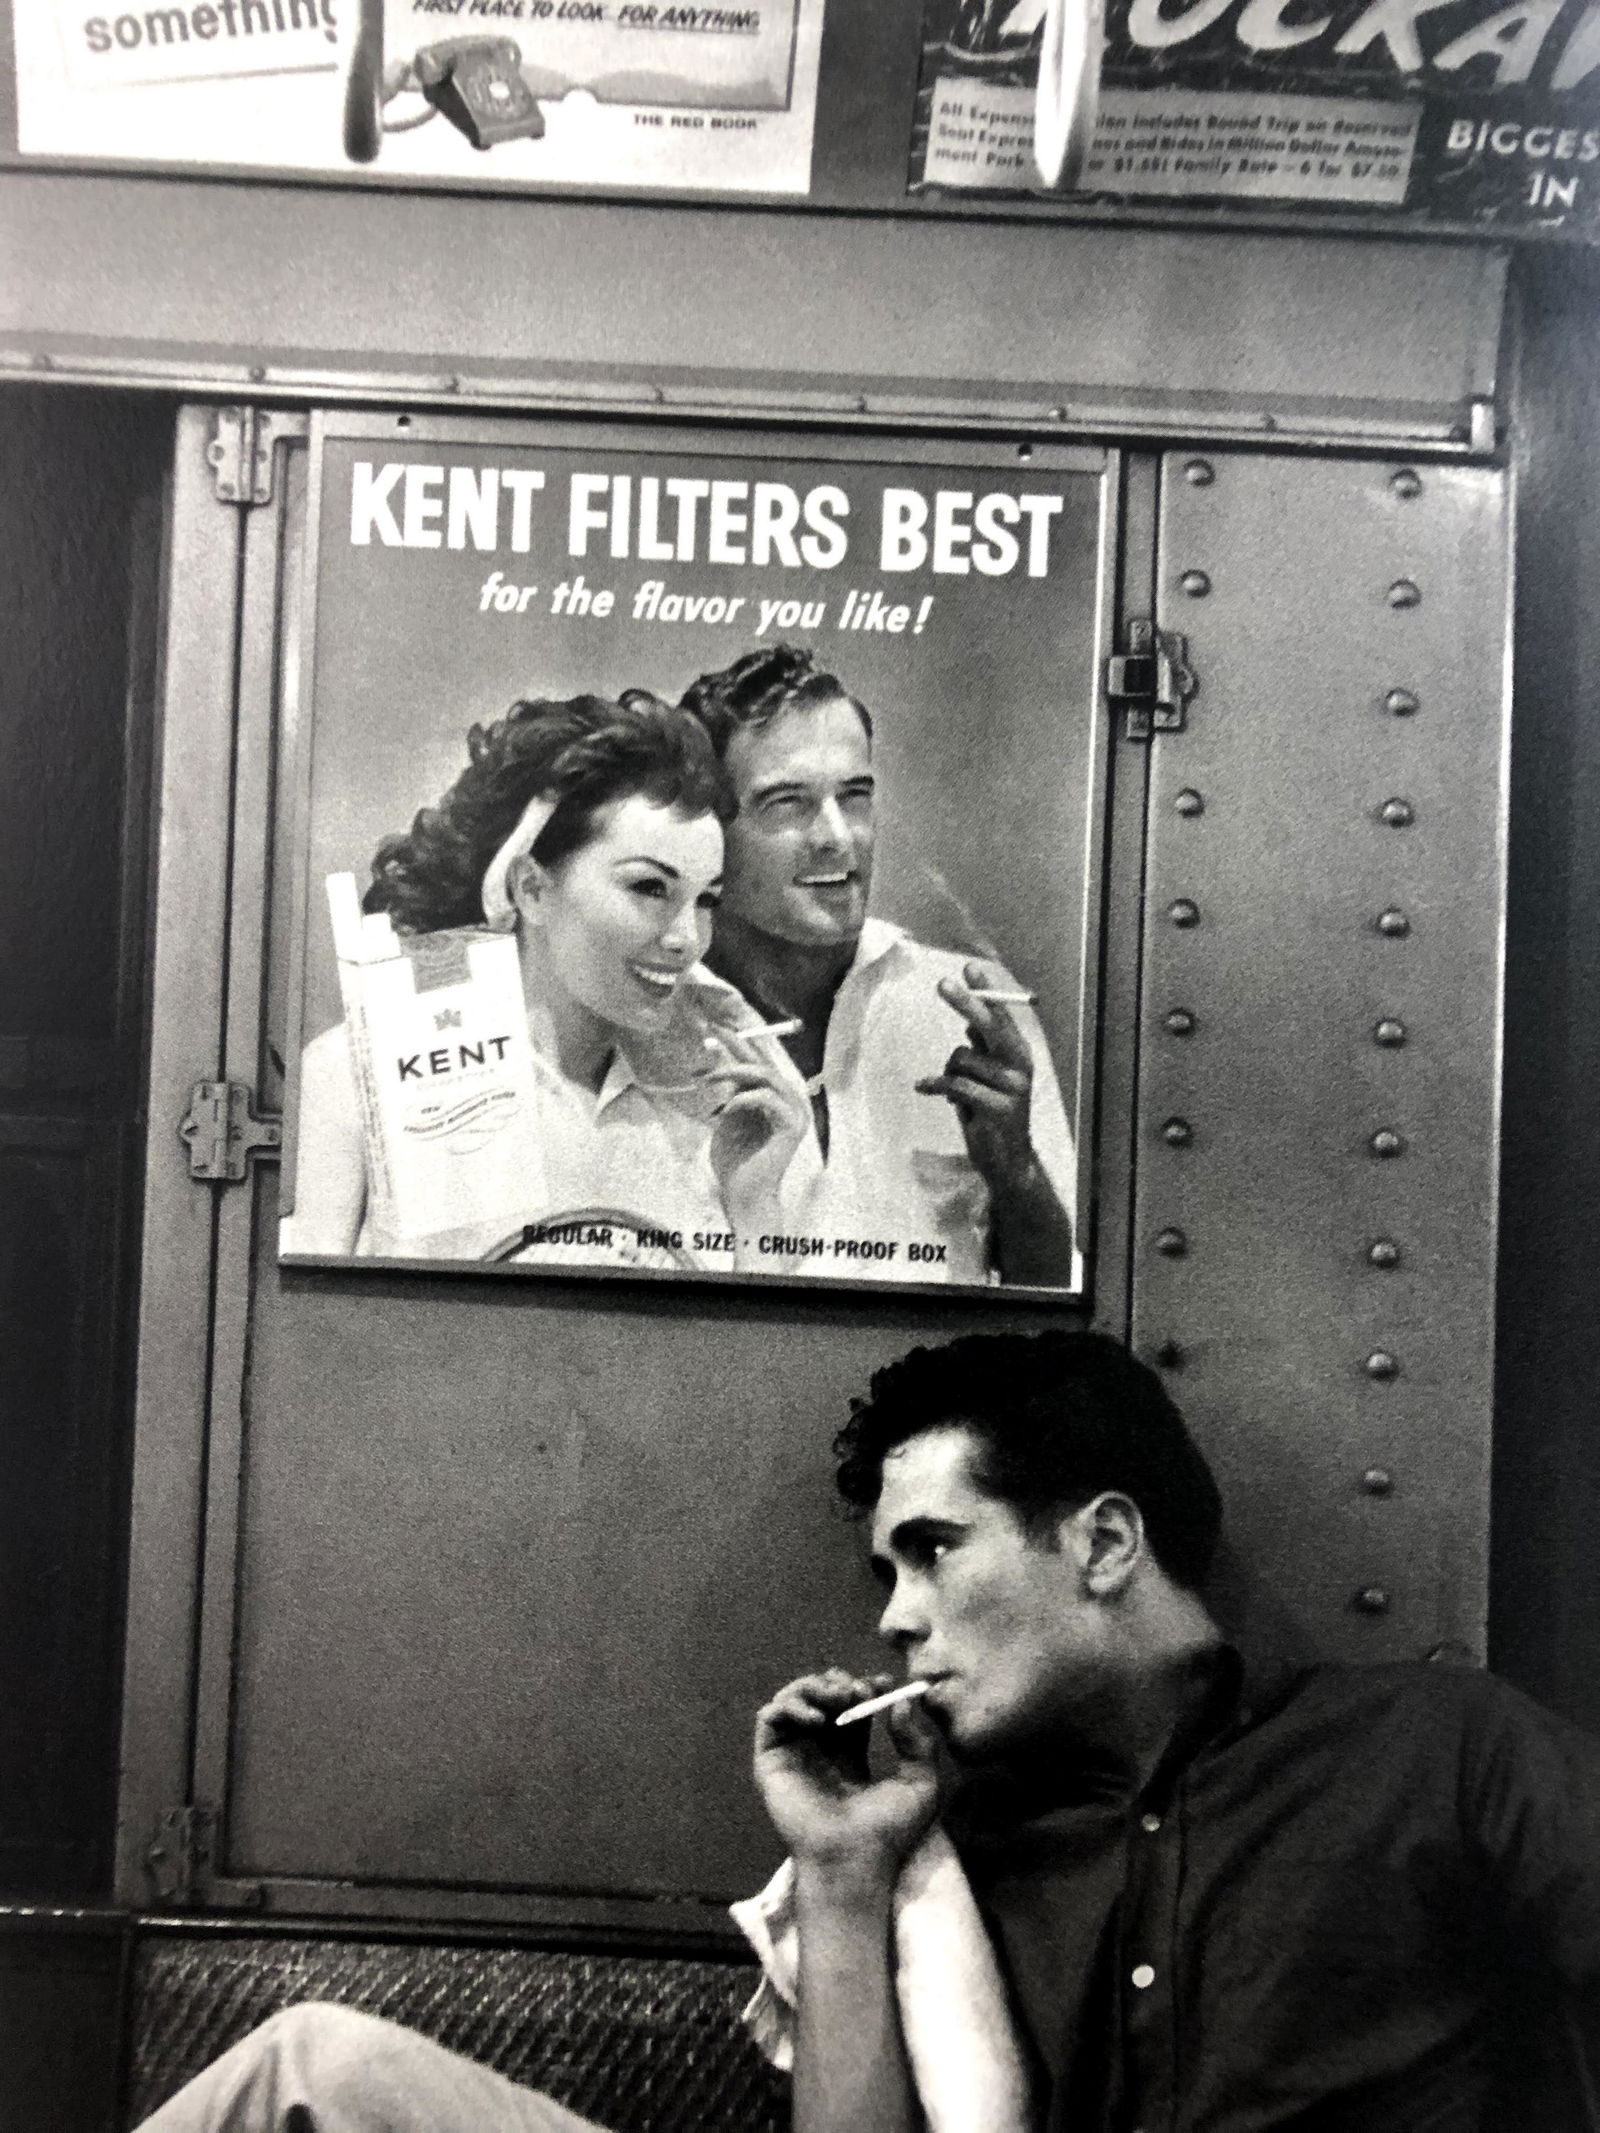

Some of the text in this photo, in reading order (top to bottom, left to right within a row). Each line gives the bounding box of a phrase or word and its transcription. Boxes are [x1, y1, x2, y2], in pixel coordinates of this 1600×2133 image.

[468, 0, 524, 18] PLACE
[531, 1, 556, 19] TO
[556, 1, 604, 22] LOOK
[617, 5, 658, 24] FOR
[659, 7, 761, 29] ANYTHING
[634, 113, 758, 130] THE RED BOOK
[1528, 170, 1579, 207] IN
[349, 461, 1064, 579] KENT FILTERS BEST
[479, 571, 934, 635] for the flavor you like!
[397, 1035, 512, 1082] KENT
[522, 1224, 614, 1249] REGULAR
[636, 1227, 683, 1250] KING
[692, 1231, 737, 1252] SIZE
[907, 1242, 948, 1263] BOX
